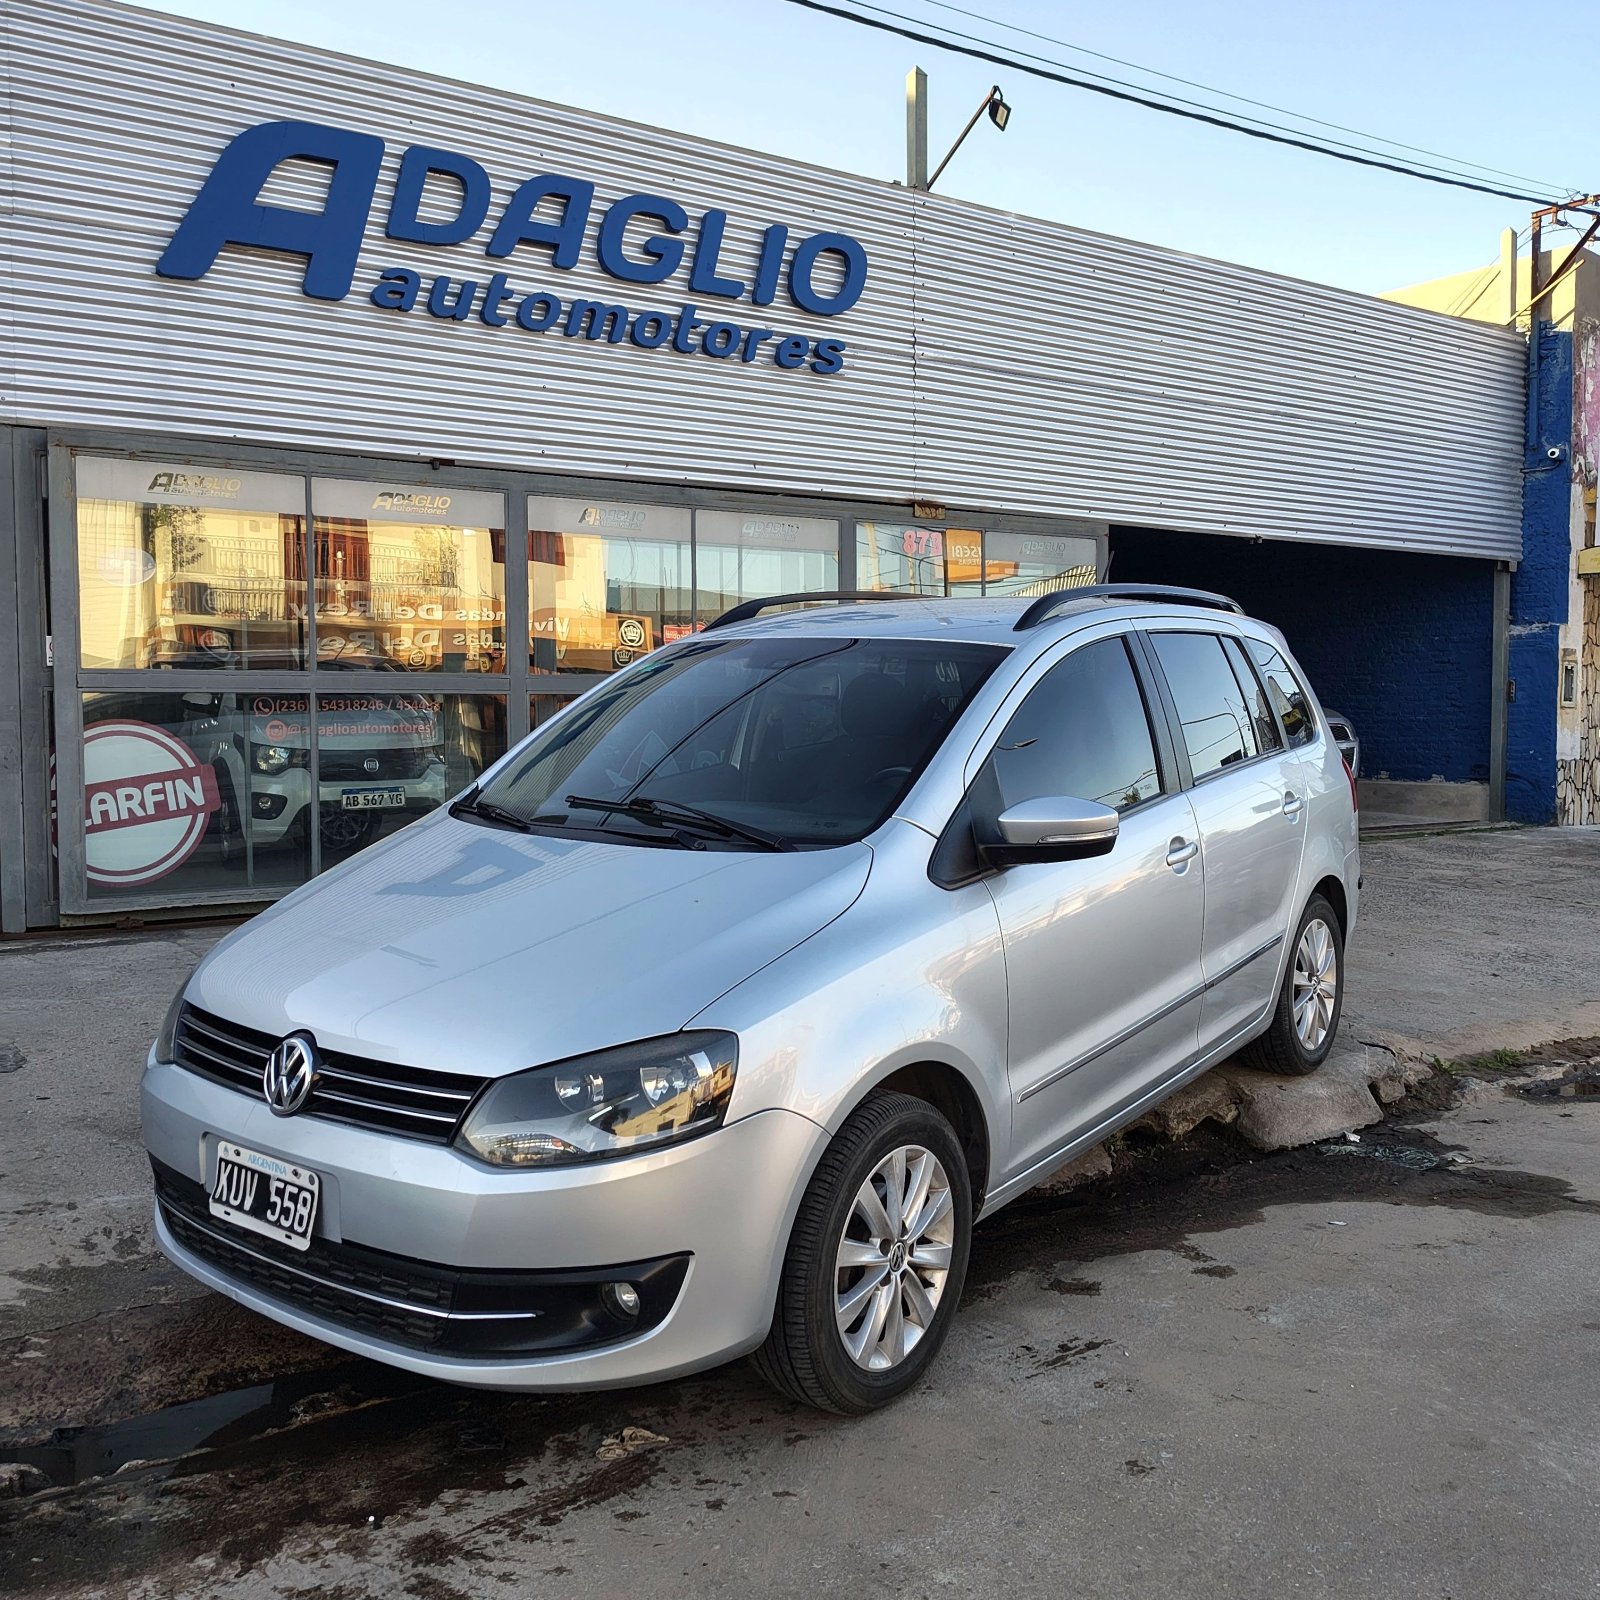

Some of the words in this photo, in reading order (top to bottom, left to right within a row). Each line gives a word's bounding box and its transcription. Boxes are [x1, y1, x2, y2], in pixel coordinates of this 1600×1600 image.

[155, 121, 868, 317] ADAGLIO
[370, 266, 846, 375] automotores
[148, 472, 242, 492] ADAGLIO
[372, 491, 451, 511] ADAGLIO
[391, 505, 447, 515] automotores
[276, 699, 309, 713] (236)
[287, 723, 431, 738] @aaglioautomotores
[85, 776, 205, 827] ARFIN
[345, 795, 359, 808] AB
[363, 794, 385, 806] 567
[389, 793, 403, 805] YG
[247, 1154, 287, 1177] ARGENTINA
[266, 1180, 312, 1233] 558
